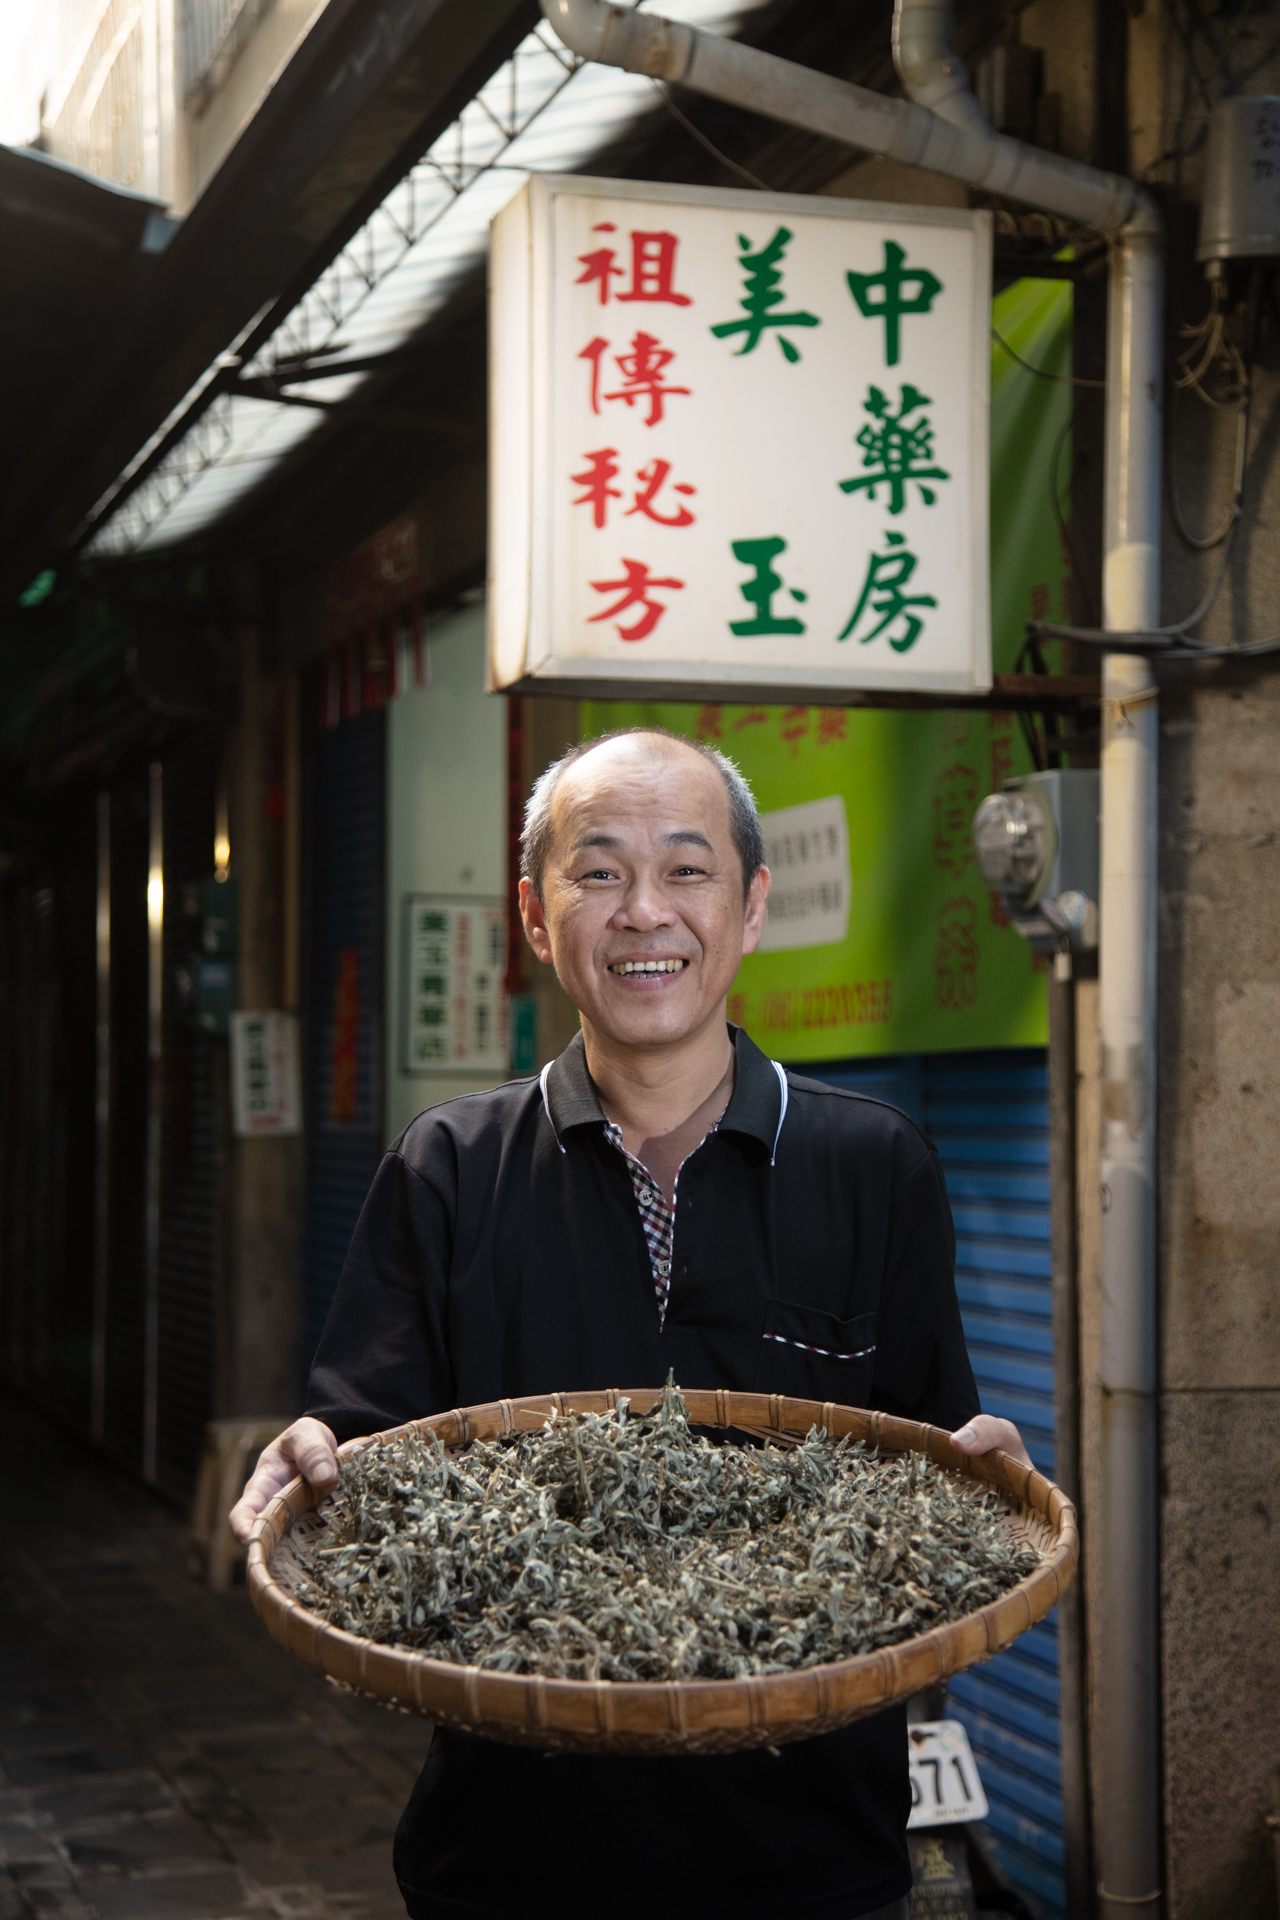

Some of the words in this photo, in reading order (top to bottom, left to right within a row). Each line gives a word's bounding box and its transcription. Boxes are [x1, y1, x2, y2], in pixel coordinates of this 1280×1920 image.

[569, 220, 697, 643] 祖傳秘方
[709, 226, 821, 637] 美玉
[837, 239, 951, 654] 中藥房
[911, 1756, 973, 1807] 71
